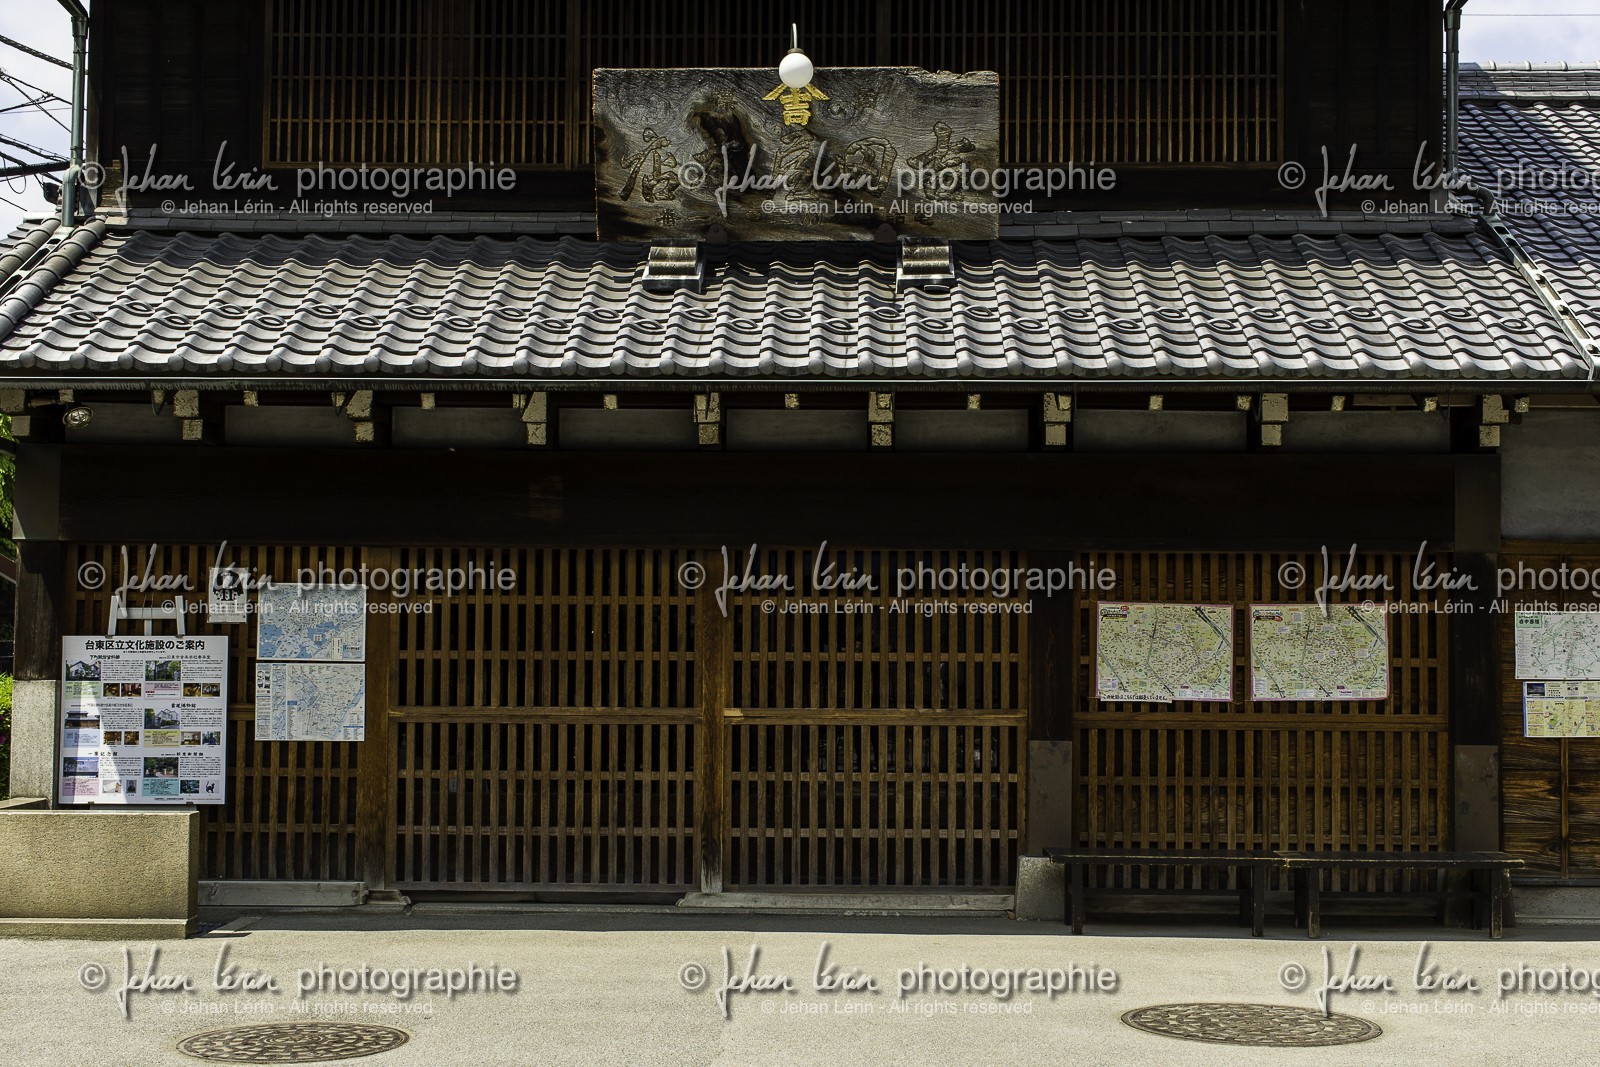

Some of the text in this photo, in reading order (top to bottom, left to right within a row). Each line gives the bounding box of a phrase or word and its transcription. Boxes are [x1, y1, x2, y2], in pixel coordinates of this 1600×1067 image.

[84, 639, 206, 651] 台東区立文化施設のご案内
